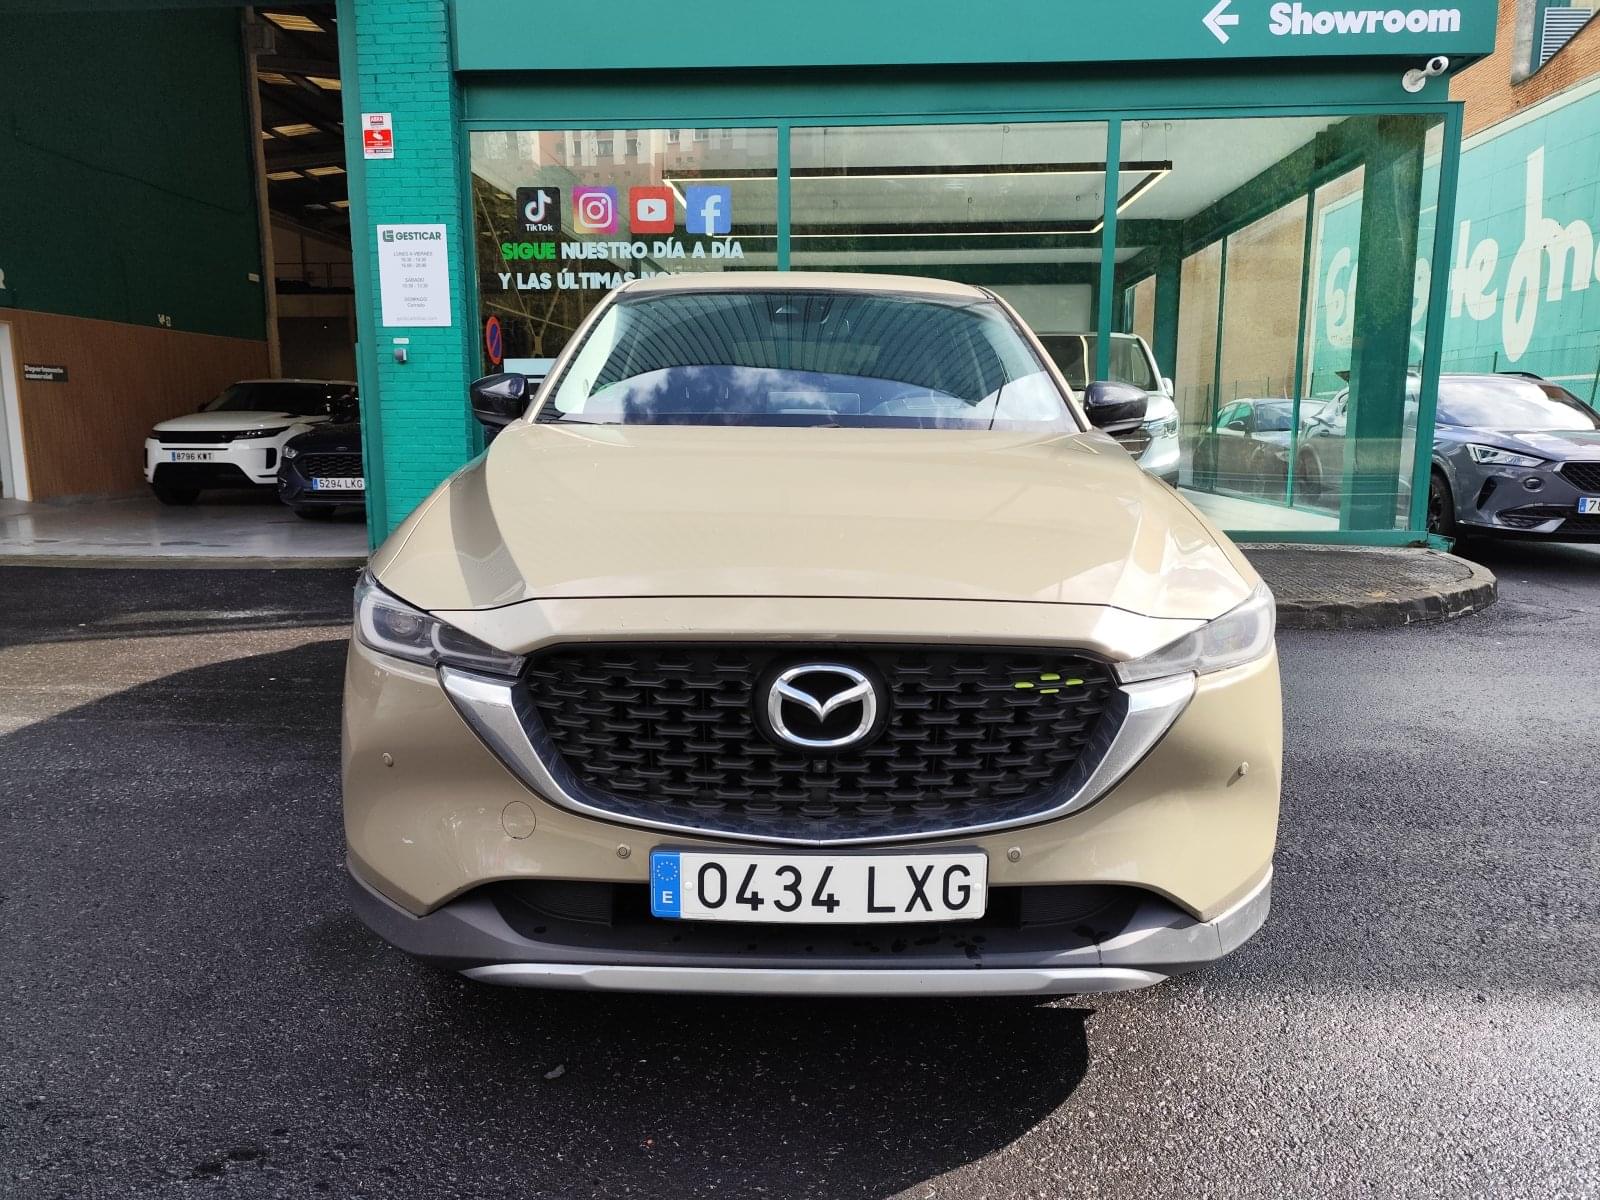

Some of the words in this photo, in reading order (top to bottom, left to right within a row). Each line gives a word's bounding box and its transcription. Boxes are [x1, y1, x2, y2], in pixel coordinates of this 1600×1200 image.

[1269, 2, 1461, 36] Showroom
[525, 223, 553, 232] TikTok
[395, 231, 442, 241] GESTICAR
[501, 242, 557, 261] SIGUE
[561, 241, 648, 260] NUESTRO
[653, 236, 685, 259] DÍA
[691, 241, 706, 259] A
[711, 236, 744, 259] DÍA
[498, 273, 513, 290] Y
[517, 272, 552, 290] LAS
[319, 479, 342, 489] 5294
[344, 479, 363, 489] LKG
[697, 861, 841, 914] 0434
[867, 863, 971, 914] LXG
[662, 890, 674, 904] E
